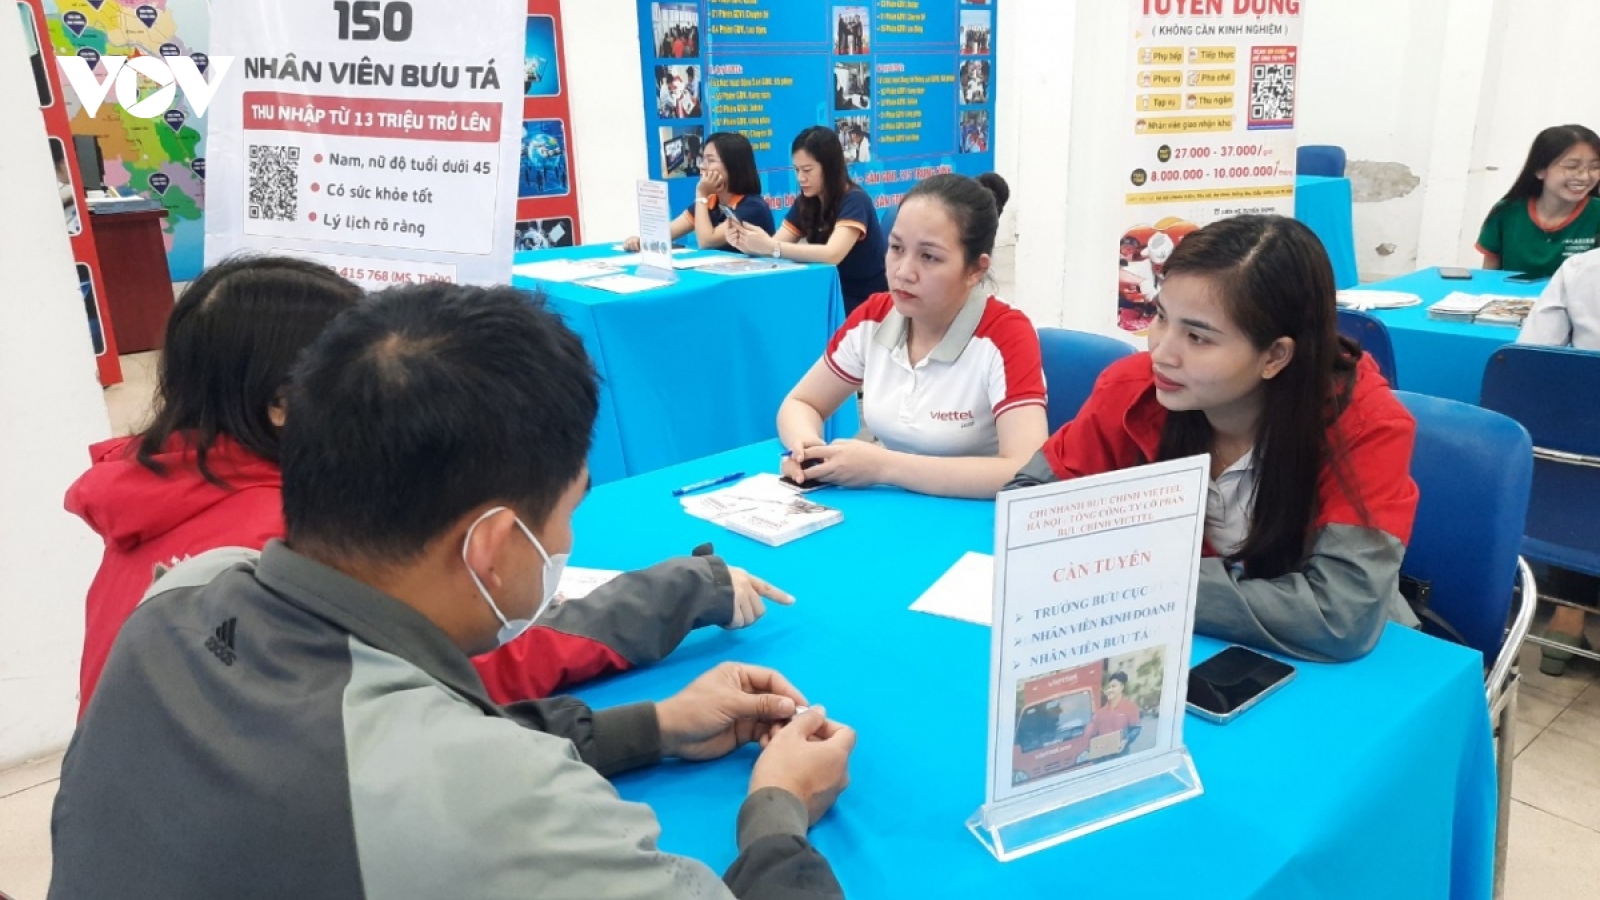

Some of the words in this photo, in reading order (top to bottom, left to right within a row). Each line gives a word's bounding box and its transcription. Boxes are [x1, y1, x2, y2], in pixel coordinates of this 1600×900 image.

[334, 0, 413, 41] 150
[1159, 23, 1193, 35] KHÔNG
[1218, 25, 1242, 35] KINH
[245, 52, 322, 83] NHÂN
[329, 56, 394, 85] VIÊN
[401, 62, 459, 88] BƯU
[466, 58, 501, 89] TÁ
[252, 104, 274, 120] THU
[278, 104, 326, 127] NHẬP
[328, 106, 350, 124] TỪ
[355, 111, 373, 127] 13
[377, 110, 424, 133] TRIỆU
[428, 111, 457, 130] TRỞ
[461, 112, 491, 132] LÊN
[1174, 147, 1210, 159] 27.000
[329, 153, 364, 169] Nam,
[368, 155, 386, 168] nữ
[389, 156, 406, 172] độ
[411, 155, 437, 172] tuổi
[442, 159, 469, 174] dưới
[473, 161, 491, 175] 45
[1151, 169, 1203, 182] 8.000.000
[327, 182, 345, 197] Có
[349, 185, 371, 199] sức
[375, 186, 408, 201] khỏe
[412, 187, 433, 203] tốt
[323, 213, 341, 230] Lý
[346, 215, 370, 231] lịch
[374, 218, 389, 231] rõ
[393, 219, 425, 238] ràng
[340, 267, 364, 279] 415
[368, 270, 389, 282] 768
[1142, 484, 1182, 498] VIETTEL
[1129, 502, 1142, 512] TY
[1114, 513, 1153, 527] VIETTEL
[1122, 585, 1150, 600] CỤC
[1031, 624, 1068, 643] NHÂN
[1070, 617, 1099, 635] VIÊN
[1100, 610, 1132, 627] KINH
[1133, 601, 1176, 620] DOANH
[1030, 648, 1067, 667] NHÂN
[1070, 641, 1100, 657] VIÊN
[1132, 626, 1149, 642] TÁ
